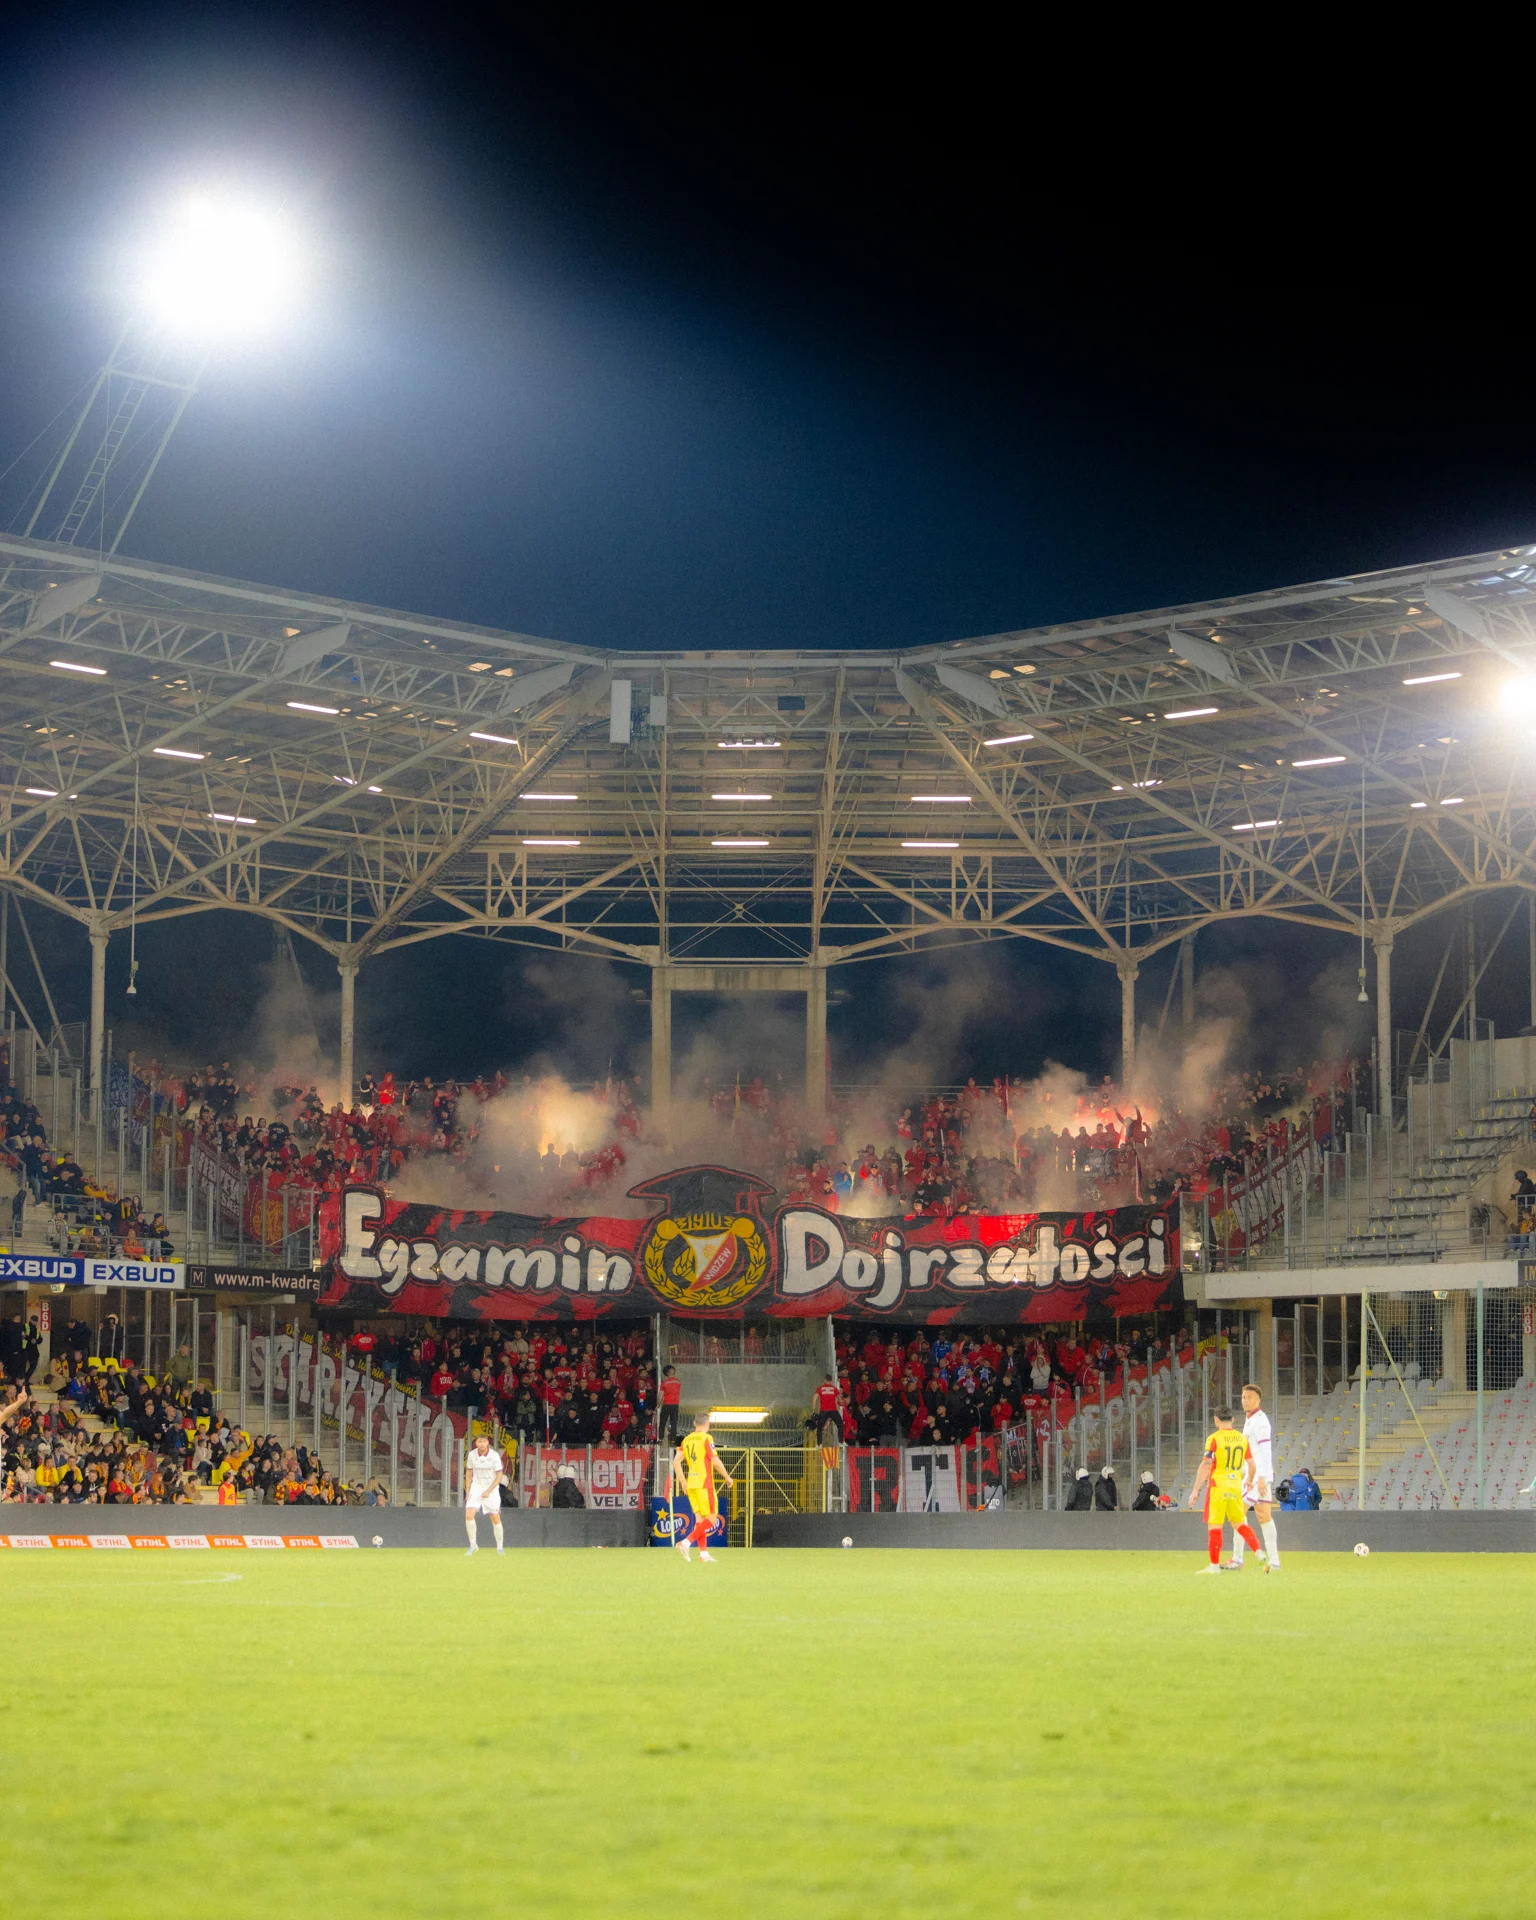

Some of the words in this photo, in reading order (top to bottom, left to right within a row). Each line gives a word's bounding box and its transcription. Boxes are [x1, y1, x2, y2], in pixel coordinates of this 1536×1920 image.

[340, 1191, 633, 1293] Egzamin
[780, 1210, 1165, 1306] Dojrzałości
[703, 1247, 732, 1281] WIDZEW
[93, 1264, 175, 1283] EXBUD
[214, 1272, 320, 1290] www.m-kwadra
[41, 1301, 50, 1331] B6D
[686, 1443, 697, 1461] 14
[1225, 1446, 1244, 1470] 10
[524, 1453, 642, 1490] Disovery
[660, 1518, 683, 1533] LOTO
[57, 1538, 87, 1546] STIHL
[96, 1538, 126, 1546] STIHL
[135, 1538, 166, 1546] STIHL
[174, 1538, 204, 1546] STIHL
[213, 1538, 244, 1546] STIHL
[251, 1538, 281, 1546] STIHL
[289, 1538, 319, 1546] STIHL
[326, 1538, 354, 1546] STIHL
